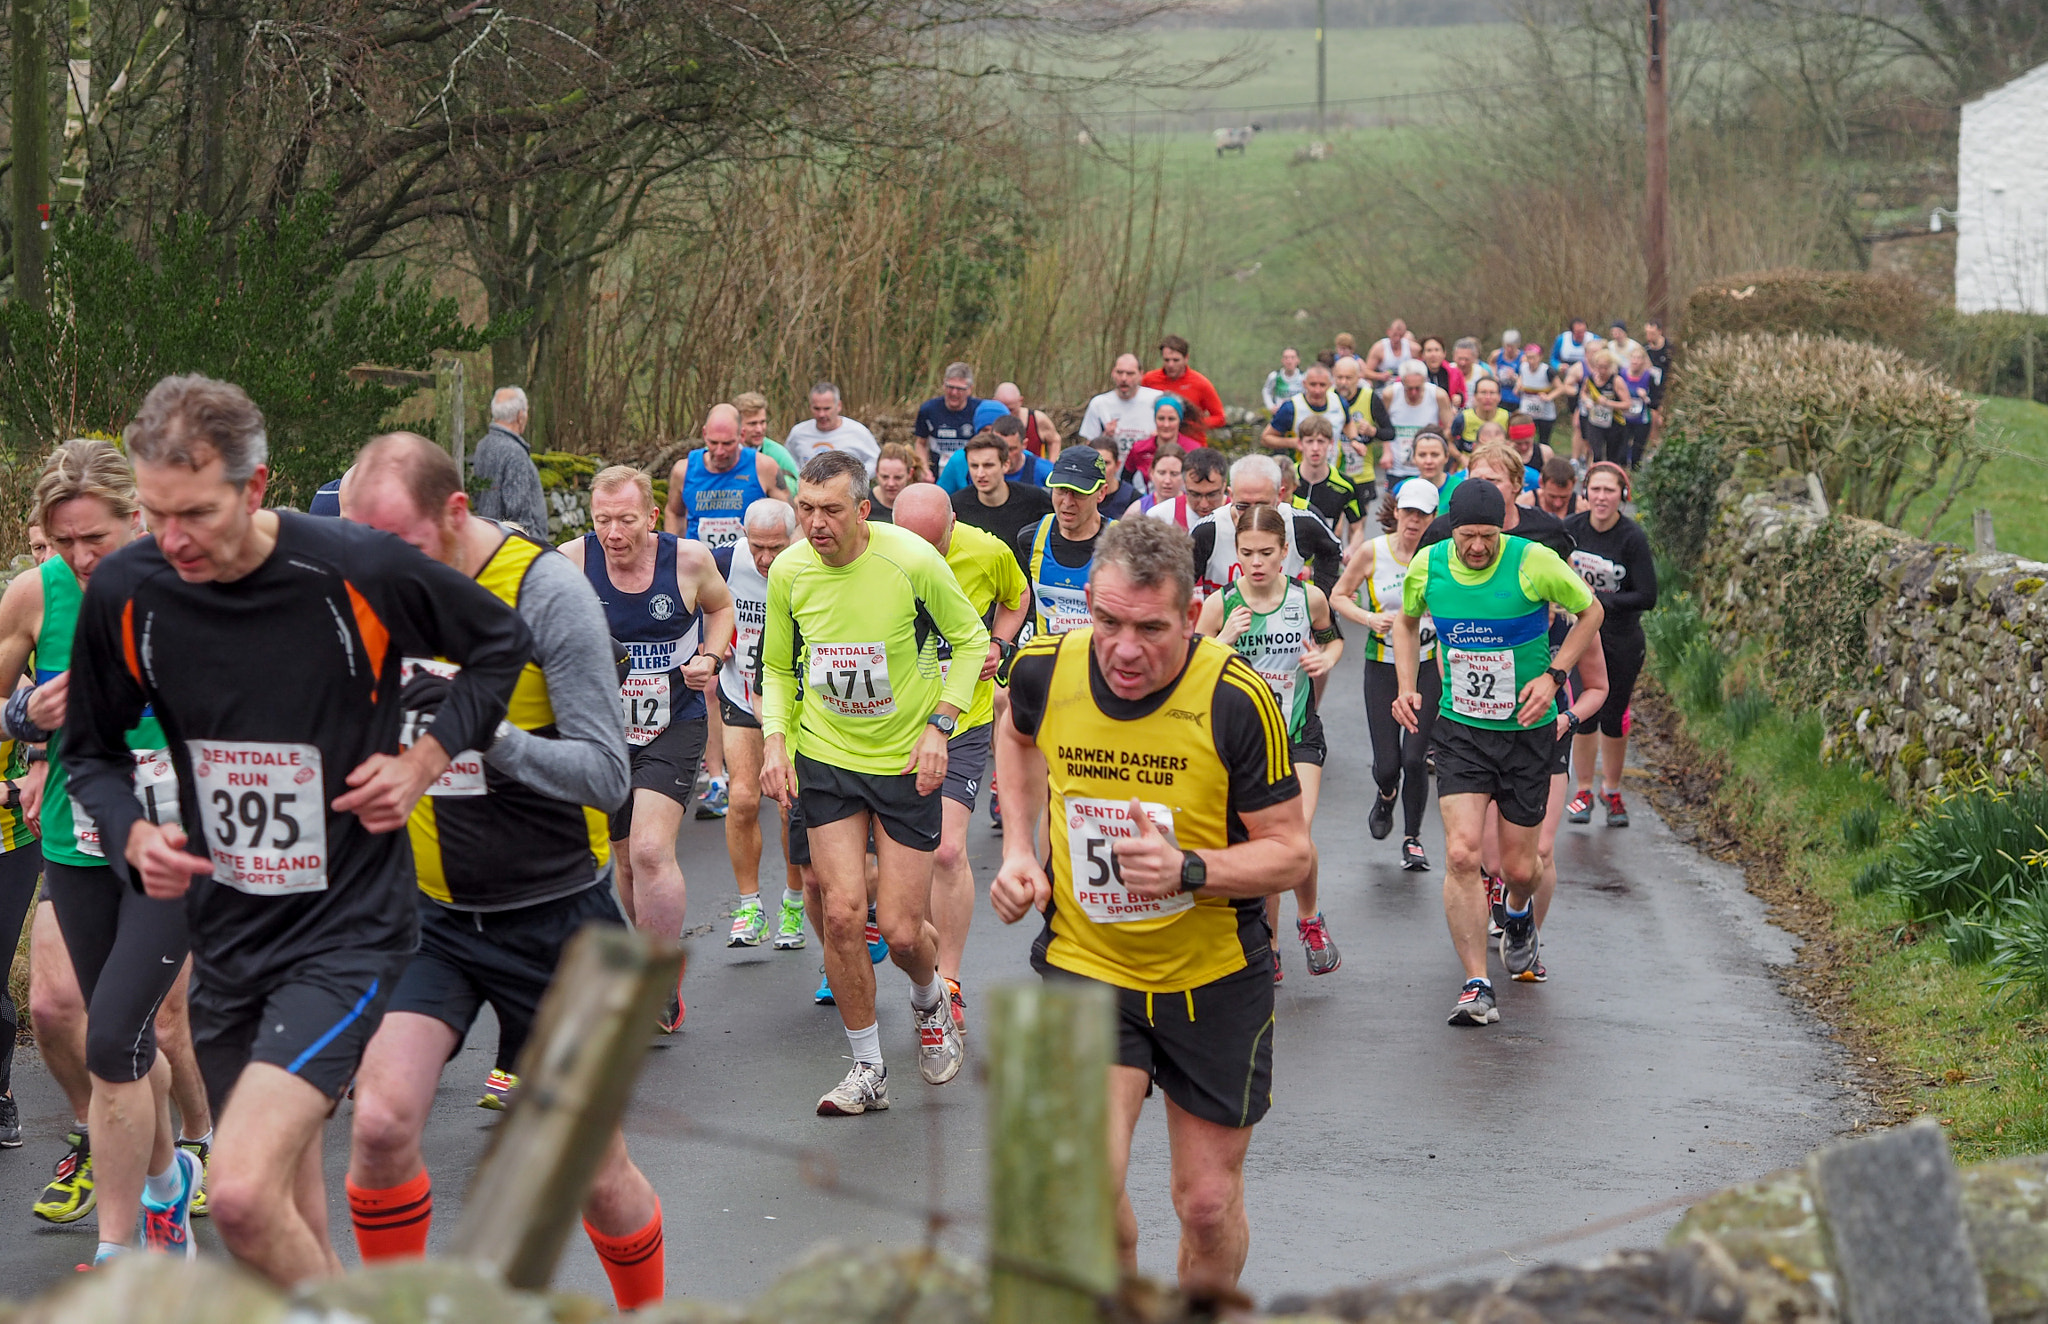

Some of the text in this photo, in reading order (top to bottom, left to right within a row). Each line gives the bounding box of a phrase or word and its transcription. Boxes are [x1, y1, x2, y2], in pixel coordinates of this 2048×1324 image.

[695, 489, 744, 500] HUNWICK
[695, 501, 743, 511] HARRIERS
[1579, 569, 1606, 587] 05
[1453, 622, 1493, 634] Eden
[1446, 633, 1504, 644] Runners
[817, 646, 876, 656] DENTDALE
[1454, 653, 1505, 662] DENTDALE
[832, 660, 857, 668] RUN
[1469, 663, 1489, 671] RUN
[826, 669, 876, 699] 171
[1466, 671, 1496, 700] 32
[621, 689, 643, 697] RUN
[822, 694, 893, 709] PETE BLAND
[1454, 696, 1514, 709] PETE BLAND
[202, 749, 302, 766] DENTDALE
[1058, 746, 1188, 770] DARWEN DASHERS
[228, 773, 268, 786] RUN
[1067, 763, 1174, 785] RUNNING CLUB
[212, 789, 300, 850] 395
[1099, 825, 1131, 838] RUN
[253, 856, 321, 871] BLAND
[233, 872, 286, 885] SPORTS
[1080, 891, 1122, 904] PETE
[1107, 903, 1160, 914] SPORTS
